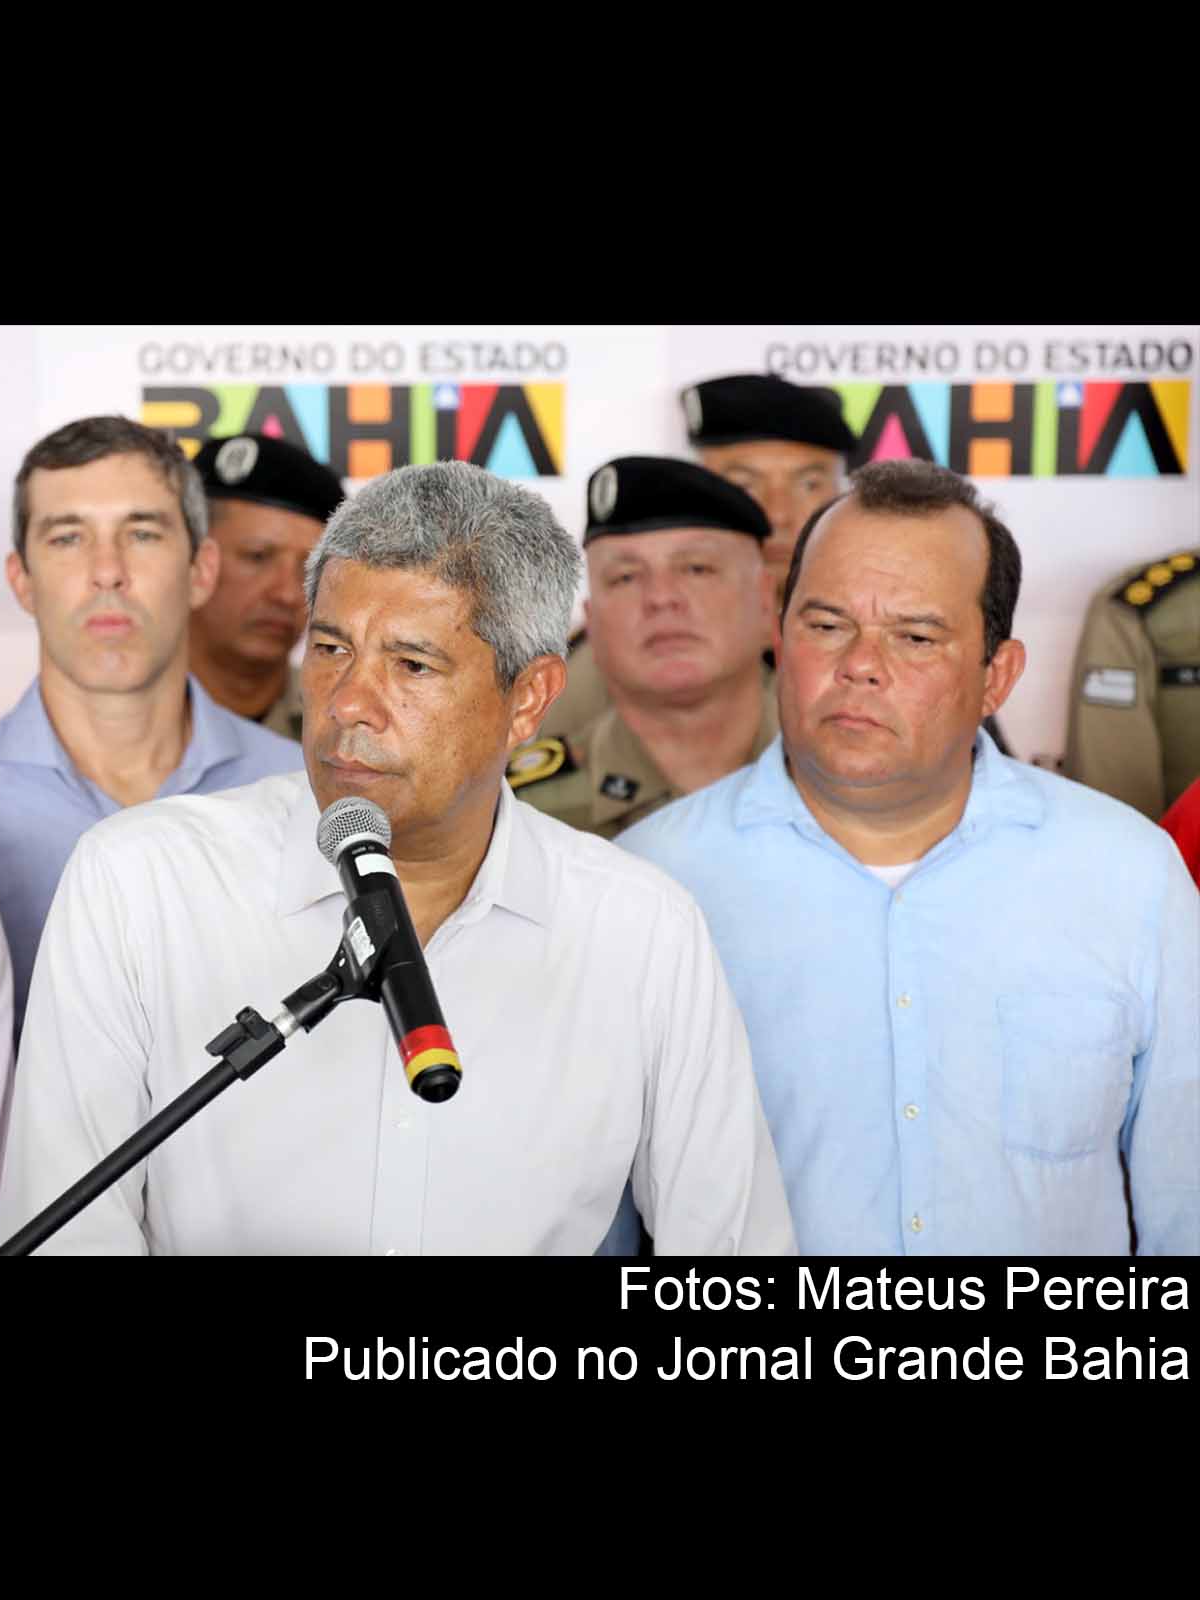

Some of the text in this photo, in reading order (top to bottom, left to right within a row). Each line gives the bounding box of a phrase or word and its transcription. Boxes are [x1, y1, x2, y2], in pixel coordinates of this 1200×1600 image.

[138, 341, 568, 374] GOVERNO DO ESTADO
[766, 340, 1193, 376] GOVERNO DO ESTADO
[850, 381, 1187, 476] AHIA
